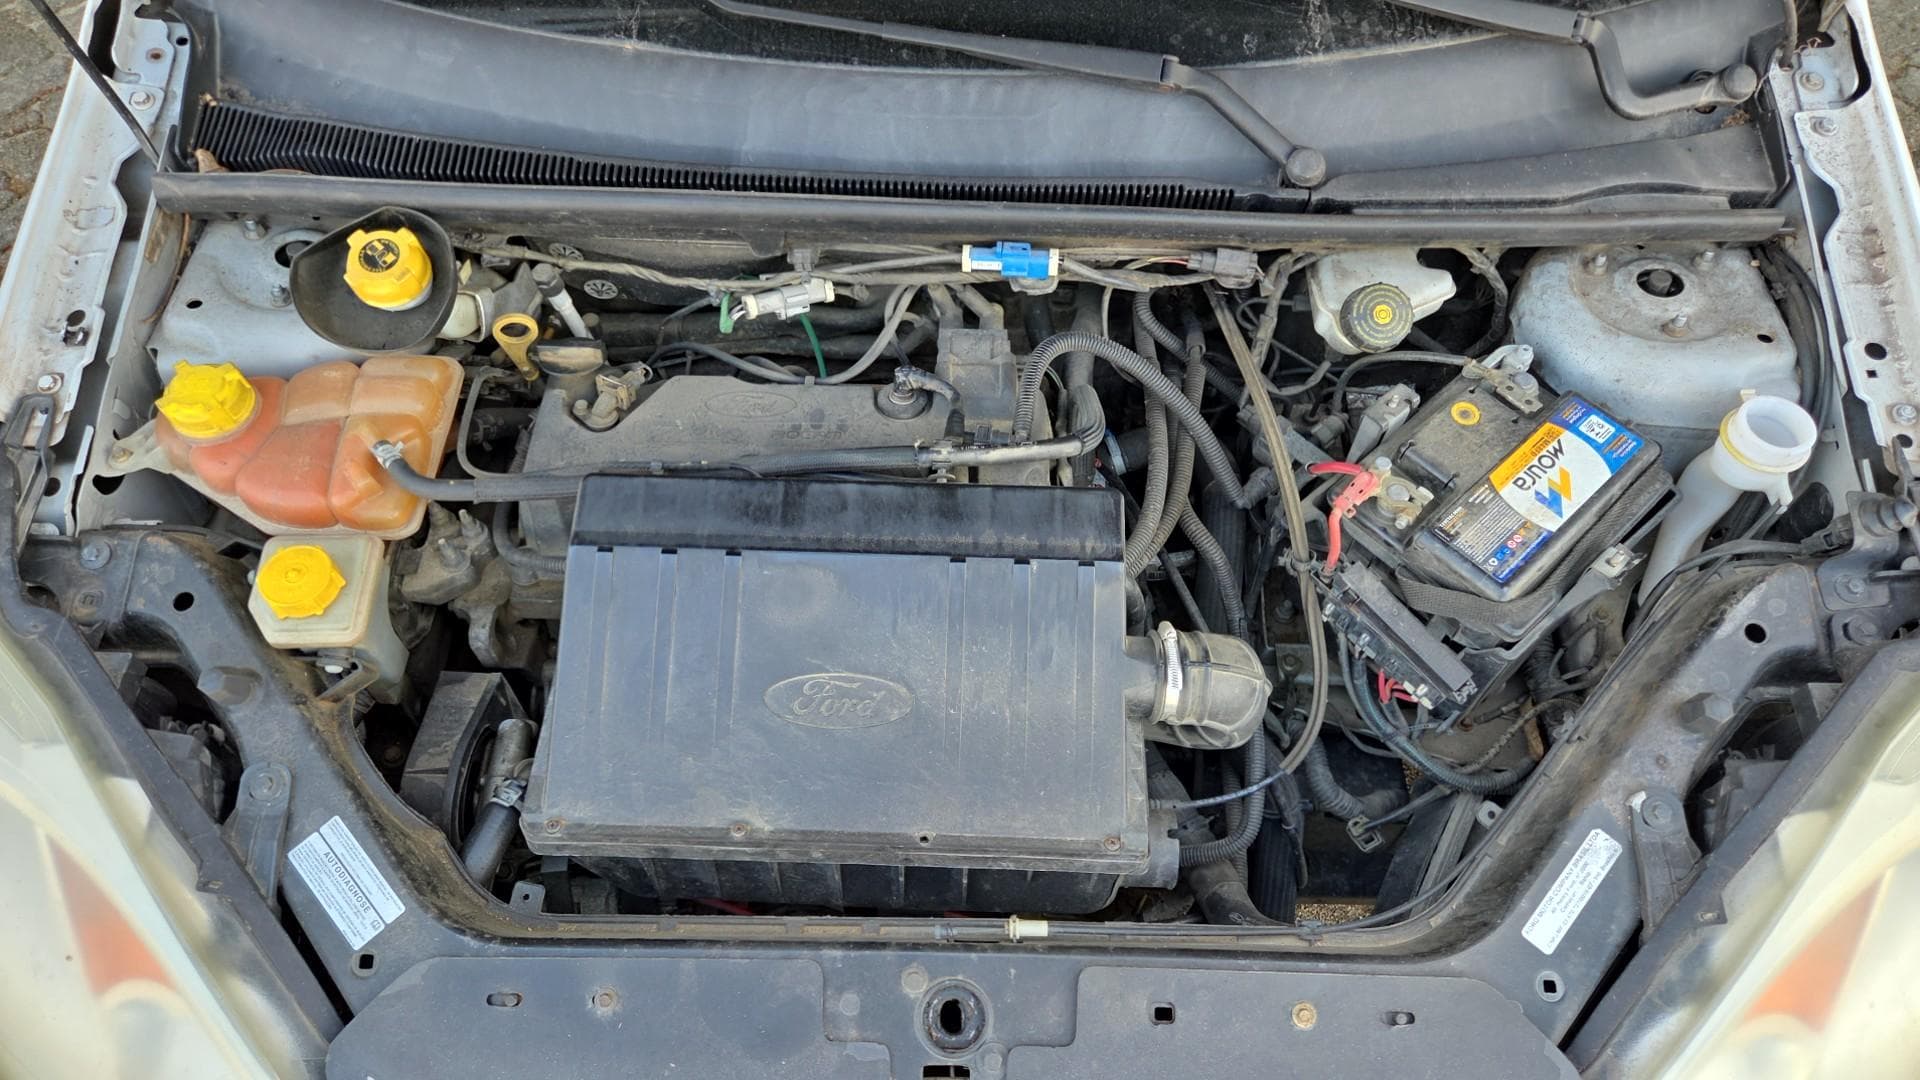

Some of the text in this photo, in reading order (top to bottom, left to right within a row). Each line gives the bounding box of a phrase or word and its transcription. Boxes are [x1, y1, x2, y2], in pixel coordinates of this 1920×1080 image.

[792, 677, 887, 718] Ford
[323, 850, 371, 914] AUTODIAGNOSE
[1536, 895, 1555, 918] MOTOR
[1551, 866, 1575, 897] COMPANY
